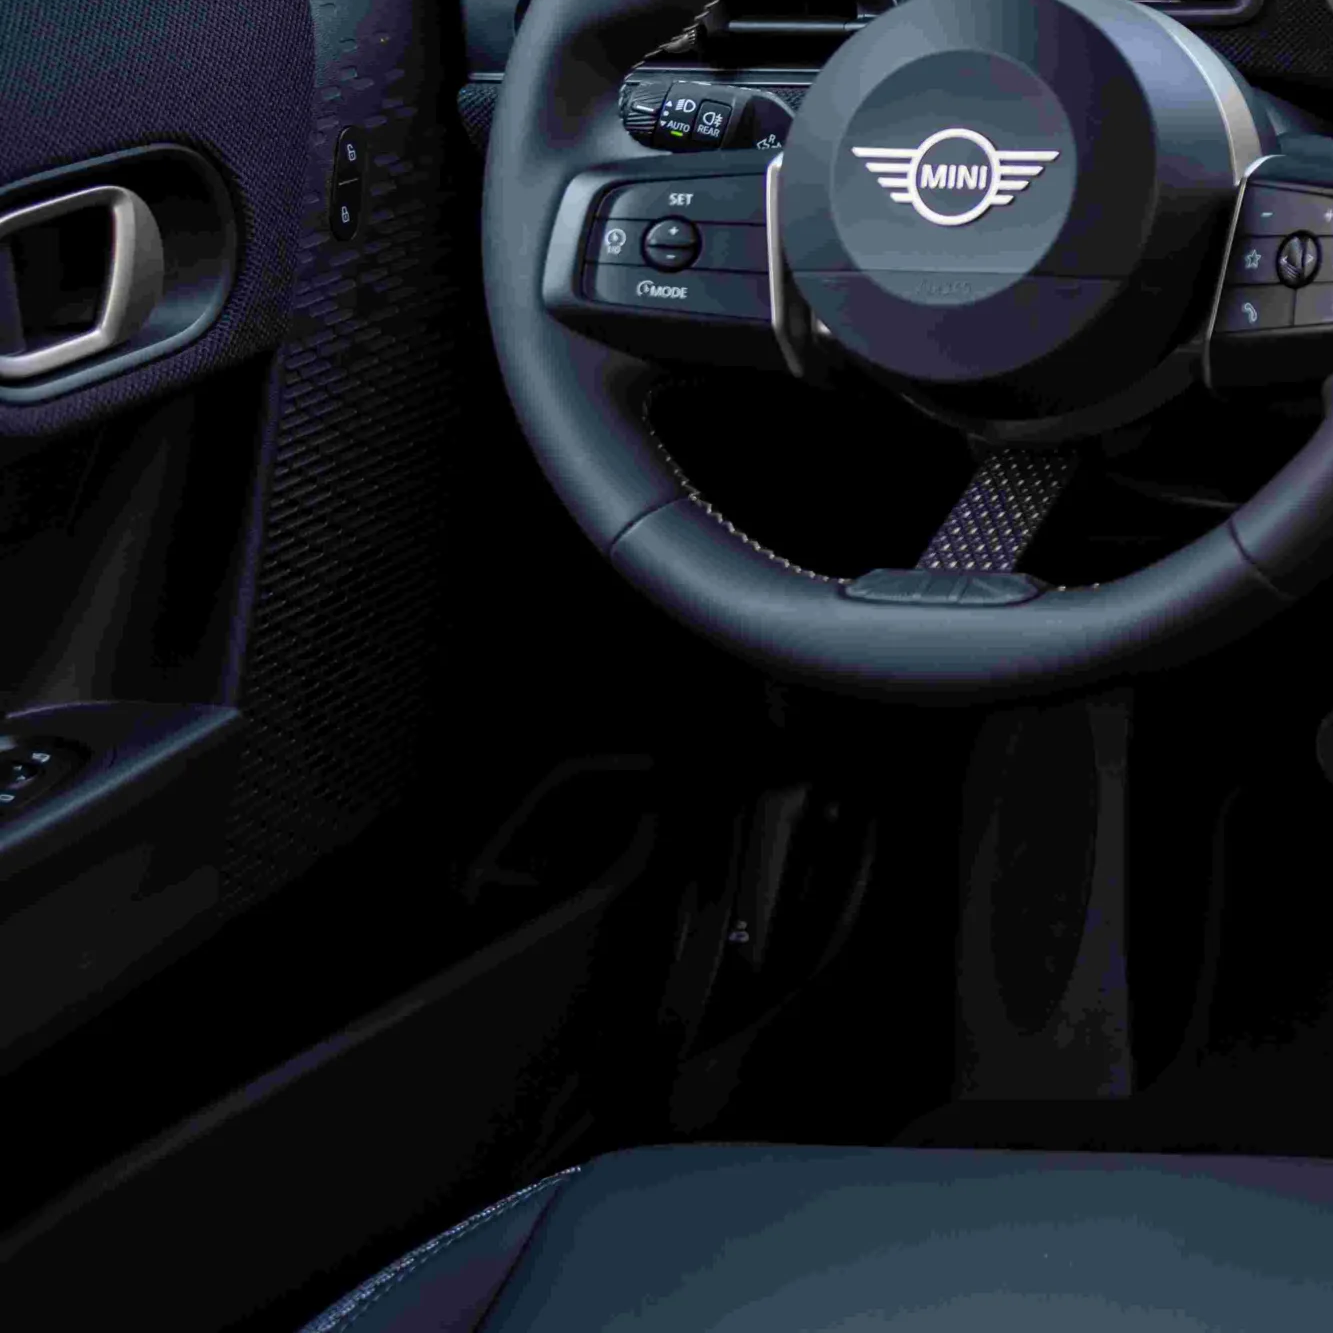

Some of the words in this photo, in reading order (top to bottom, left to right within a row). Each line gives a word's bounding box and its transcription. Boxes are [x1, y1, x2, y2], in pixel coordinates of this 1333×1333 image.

[666, 120, 691, 133] AUTO
[697, 124, 720, 138] REAR
[920, 164, 988, 190] MINI
[669, 193, 693, 206] SET
[650, 285, 689, 299] MODE
